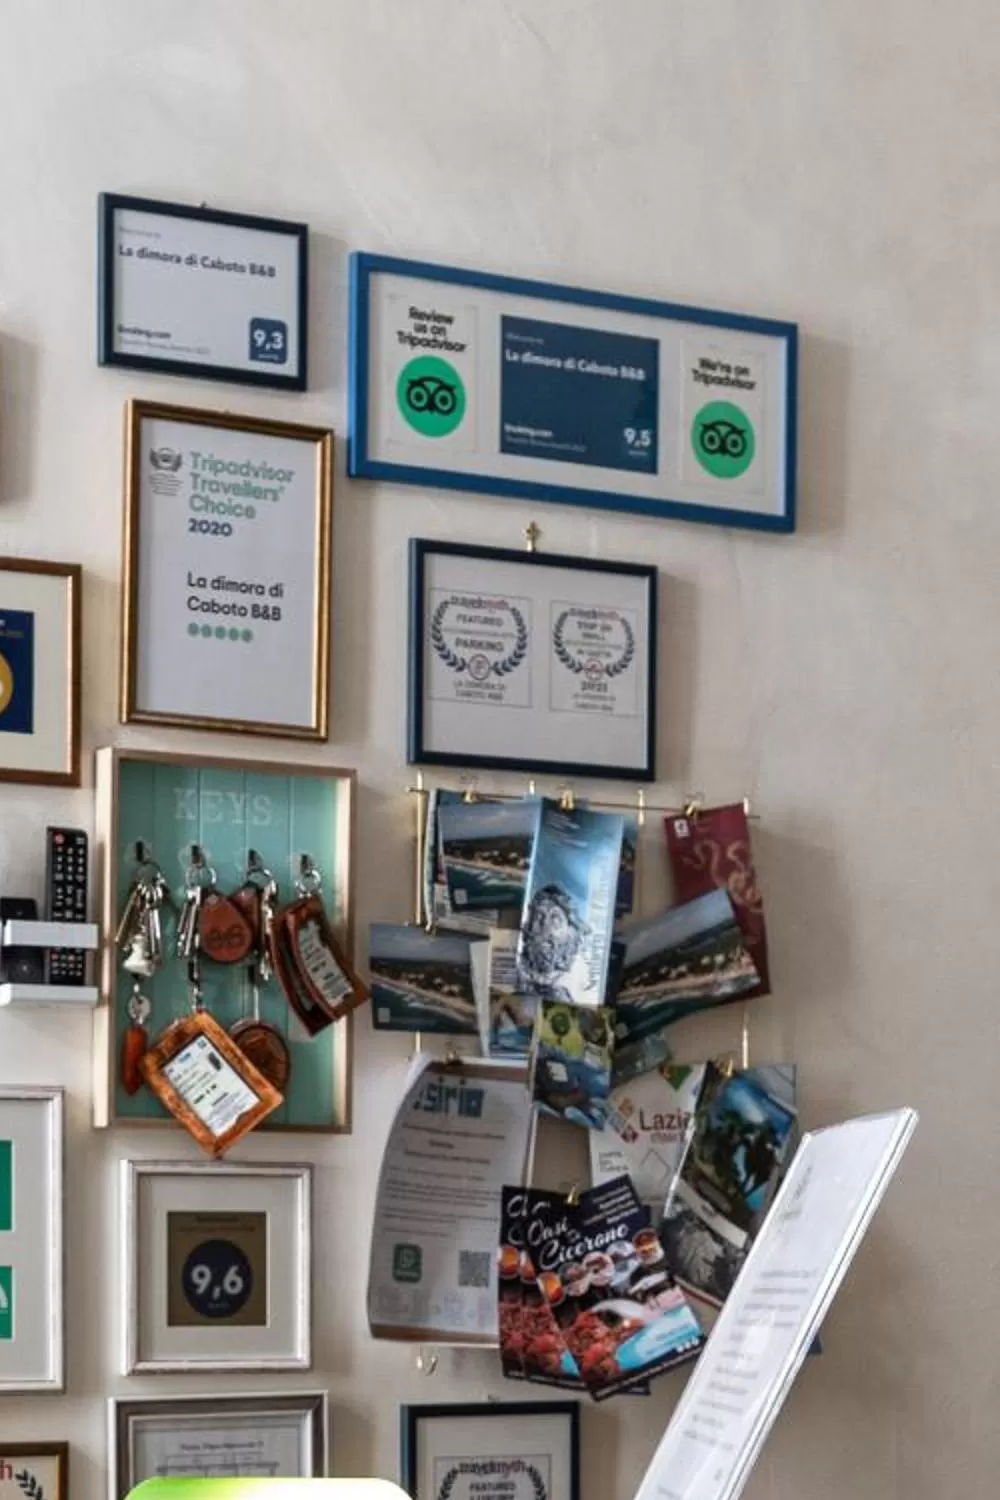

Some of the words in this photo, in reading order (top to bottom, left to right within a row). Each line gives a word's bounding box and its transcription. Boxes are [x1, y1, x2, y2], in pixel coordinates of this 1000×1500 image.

[408, 305, 455, 326] Review
[253, 328, 283, 352] 9,3
[396, 329, 467, 353] Tripadvisor
[623, 427, 651, 448] 9,5
[189, 451, 296, 484] Tripadvisor
[189, 493, 257, 520] Choice
[188, 517, 233, 537] 2020
[187, 571, 207, 589] La
[211, 575, 265, 596] dimora
[269, 581, 284, 598] di
[187, 595, 249, 618] Caboto
[251, 602, 281, 621] B&B
[172, 787, 273, 827] KEYS
[191, 1263, 244, 1301] 9,6
